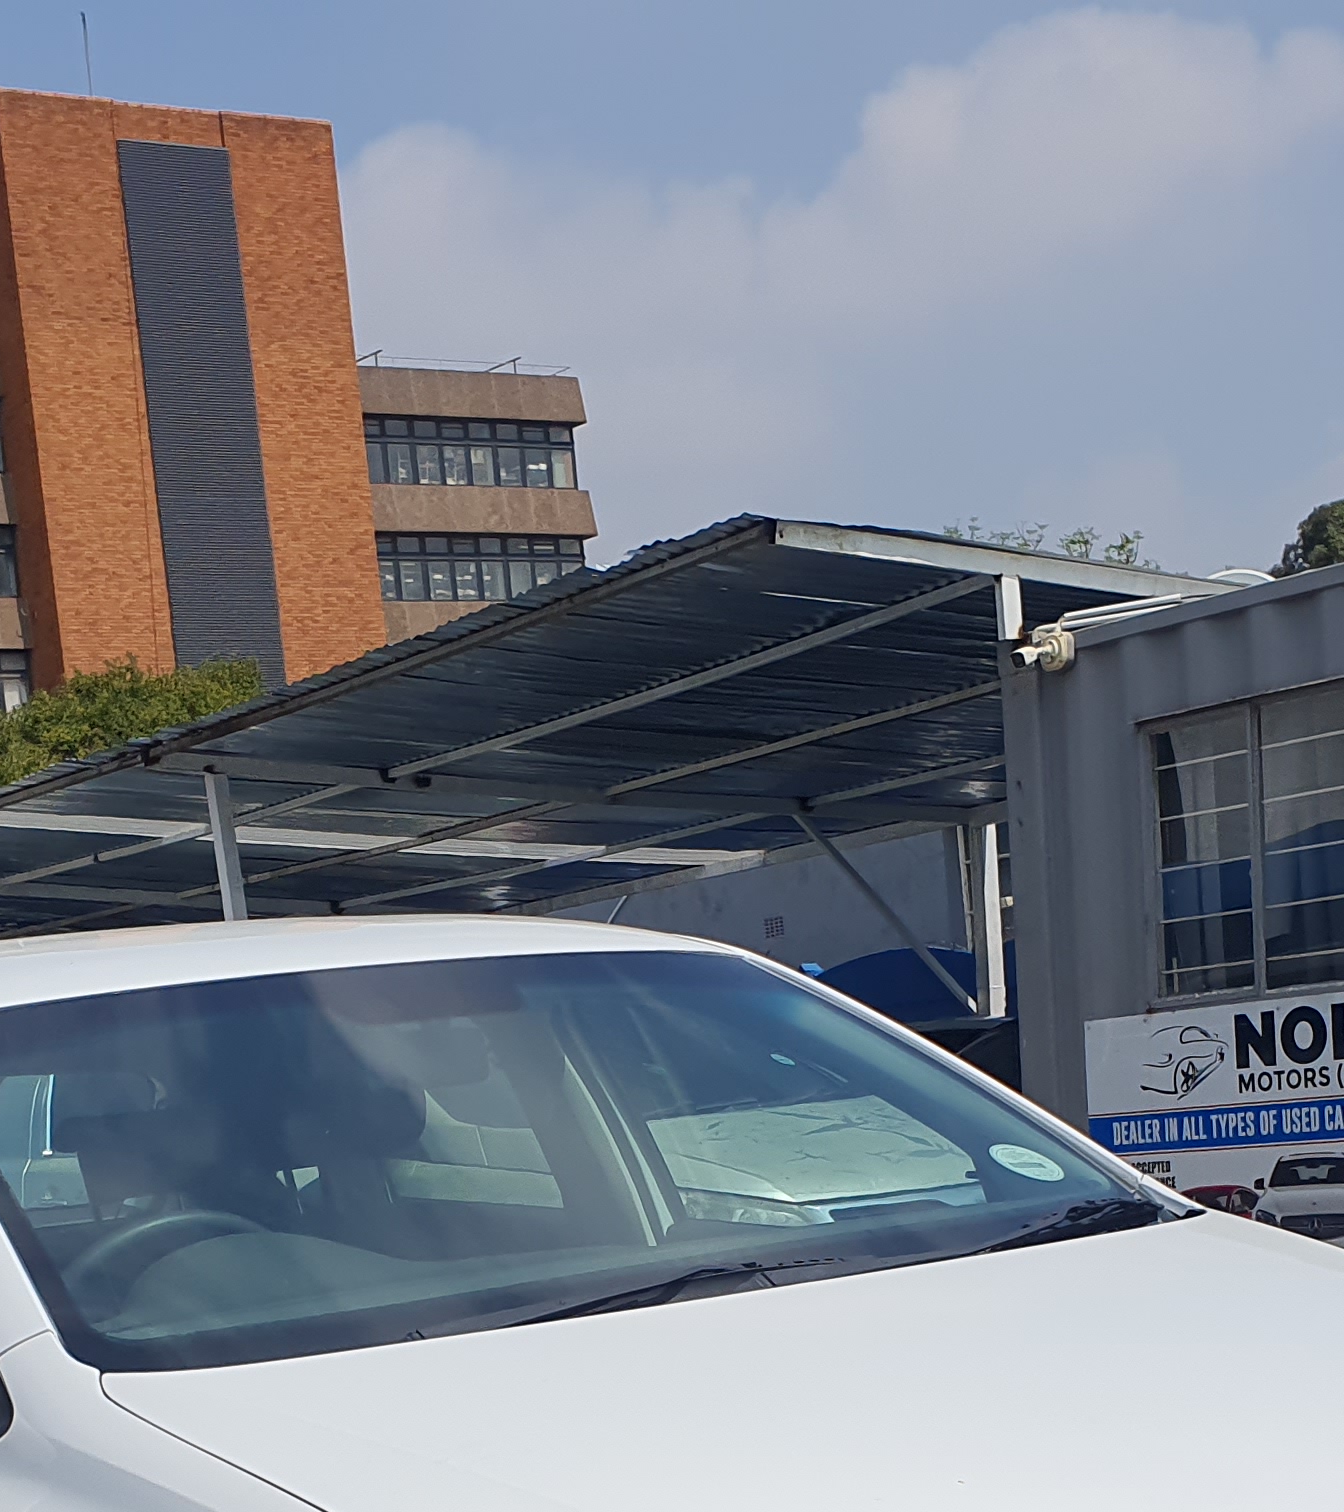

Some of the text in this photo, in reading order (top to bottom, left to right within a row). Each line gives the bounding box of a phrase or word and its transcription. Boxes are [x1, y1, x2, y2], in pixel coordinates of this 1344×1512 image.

[1238, 1066, 1331, 1094] MOTORS
[1112, 1118, 1162, 1146] DEALER
[1164, 1117, 1179, 1142] IN
[1182, 1115, 1207, 1141] ALL
[1210, 1111, 1255, 1138] TYPES
[1259, 1110, 1278, 1136] OF
[1282, 1107, 1320, 1134] USED
[1131, 1161, 1171, 1174] CCEPTED
